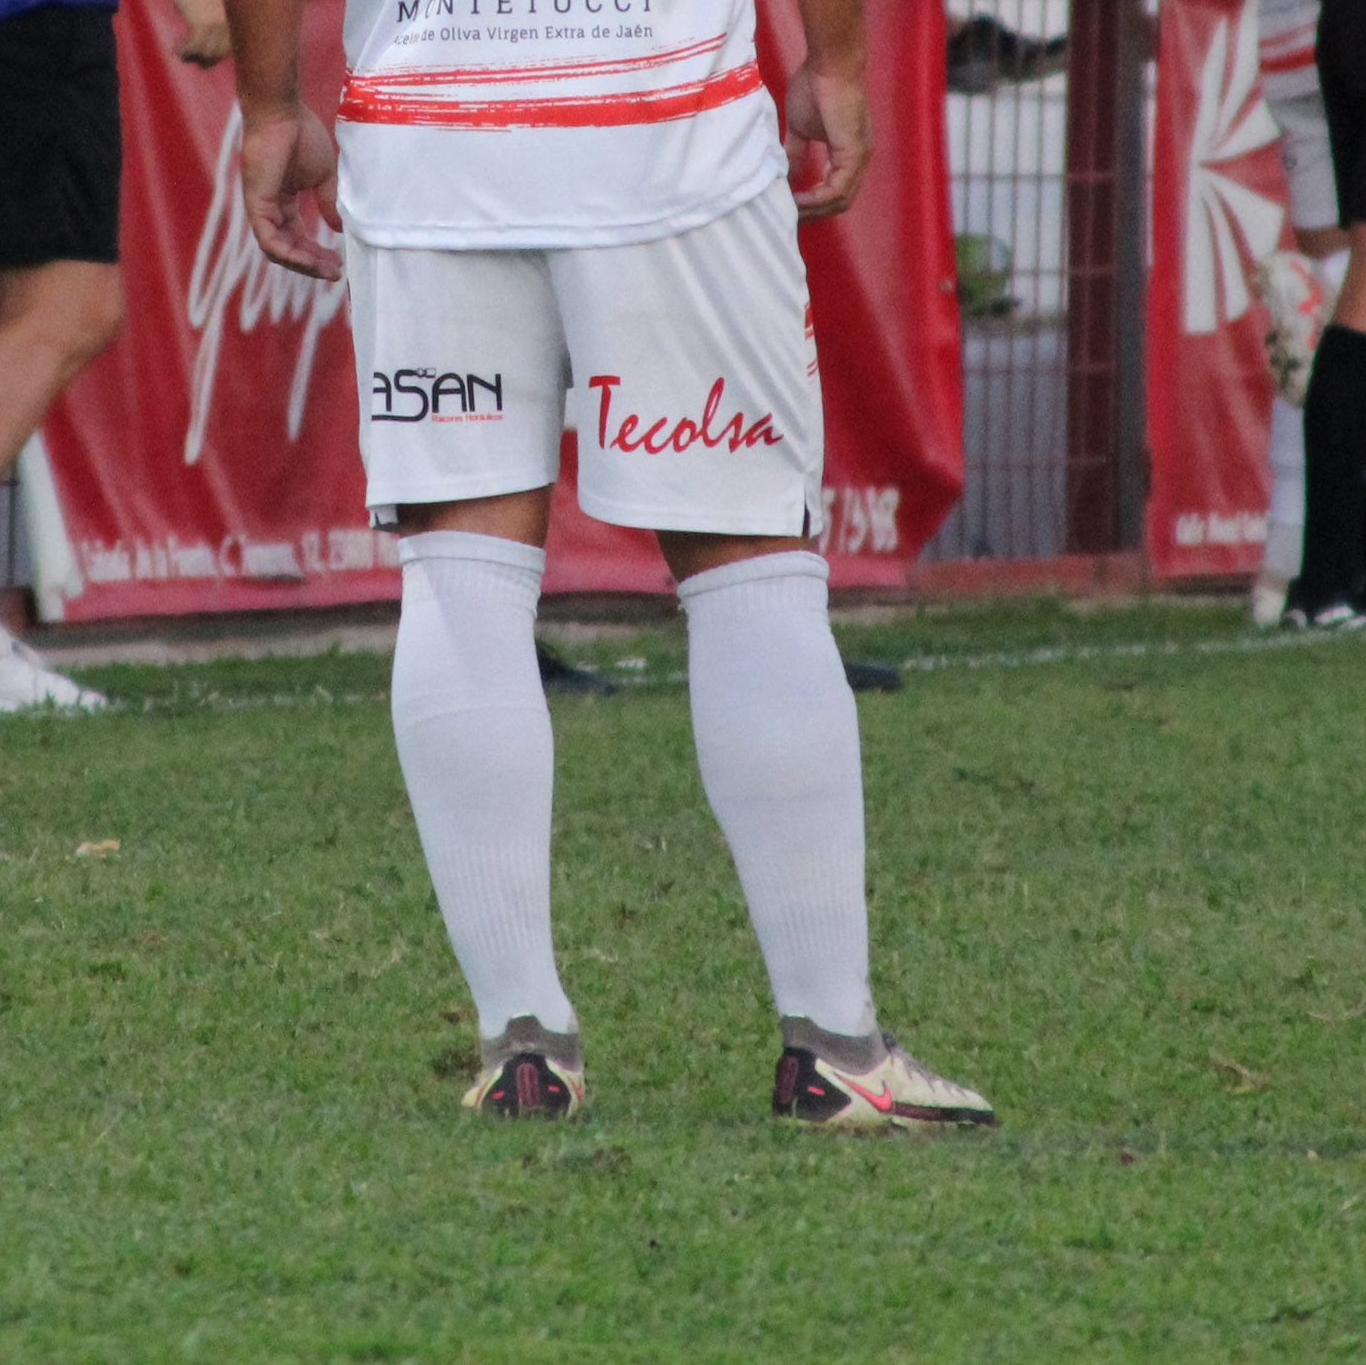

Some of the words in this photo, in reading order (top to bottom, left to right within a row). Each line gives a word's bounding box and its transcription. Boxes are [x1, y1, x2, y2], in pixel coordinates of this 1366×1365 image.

[440, 26, 481, 41] Oliva
[485, 26, 539, 43] Virgen
[545, 25, 586, 40] Extra
[591, 24, 611, 39] de
[616, 23, 654, 39] Jaén
[588, 374, 785, 456] Tecolsa
